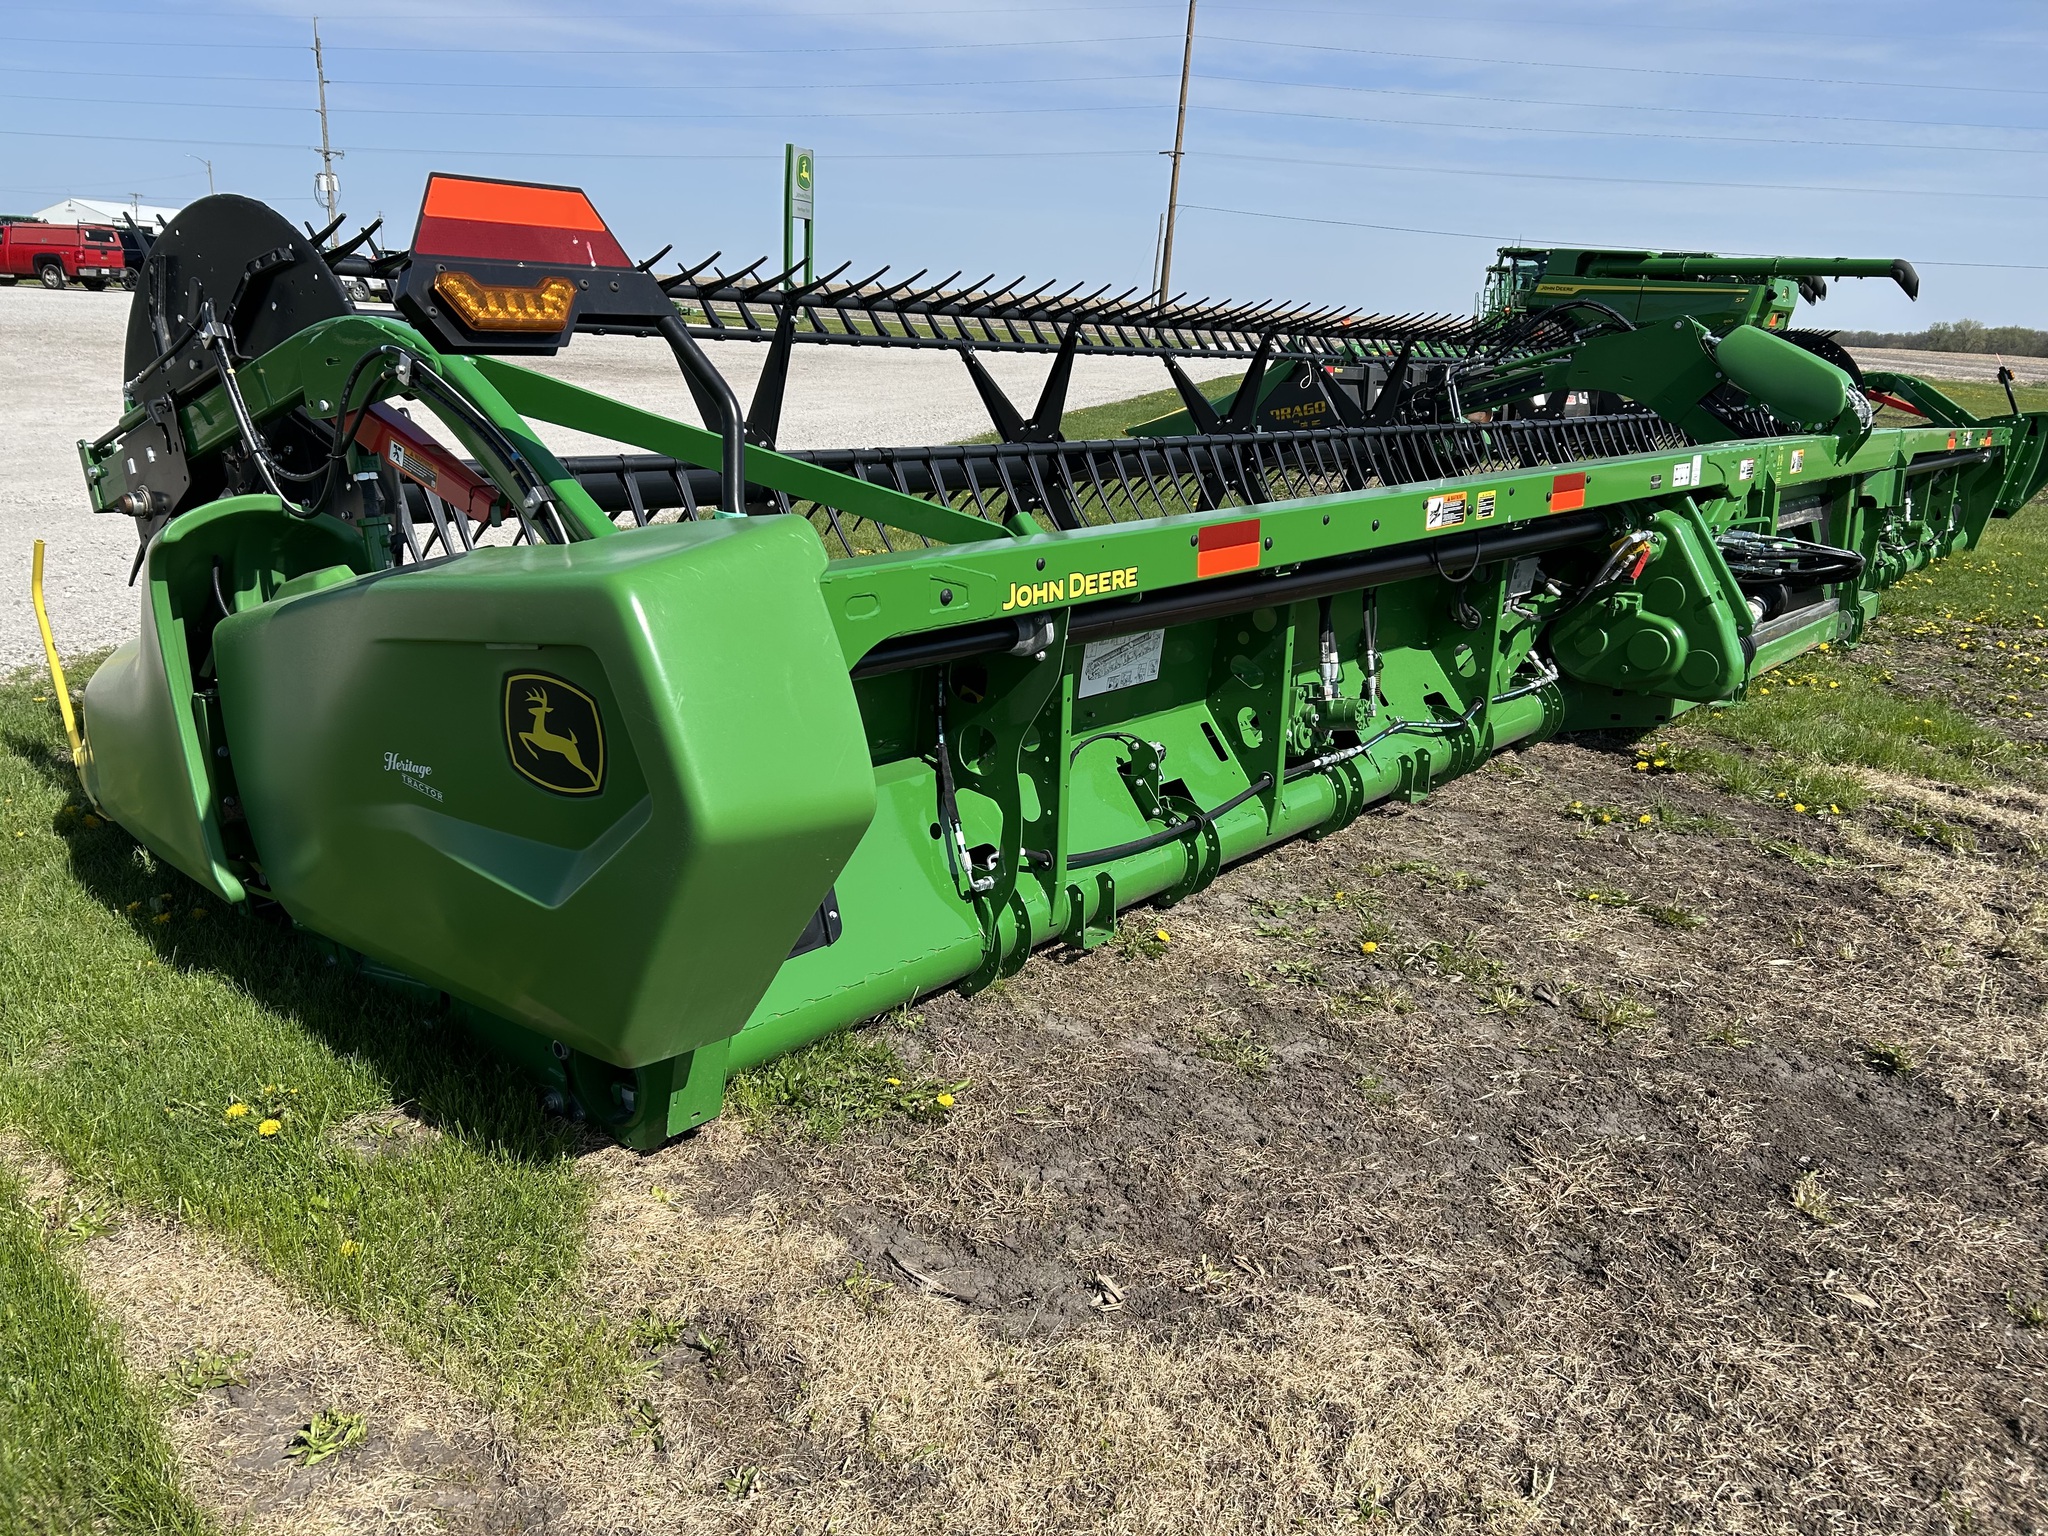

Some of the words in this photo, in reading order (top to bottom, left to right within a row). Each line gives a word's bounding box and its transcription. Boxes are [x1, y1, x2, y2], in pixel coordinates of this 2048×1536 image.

[1002, 579, 1064, 611] JOHN
[1069, 566, 1138, 599] DEERE
[384, 751, 433, 779] Heritage
[402, 774, 443, 801] TRACTOR
